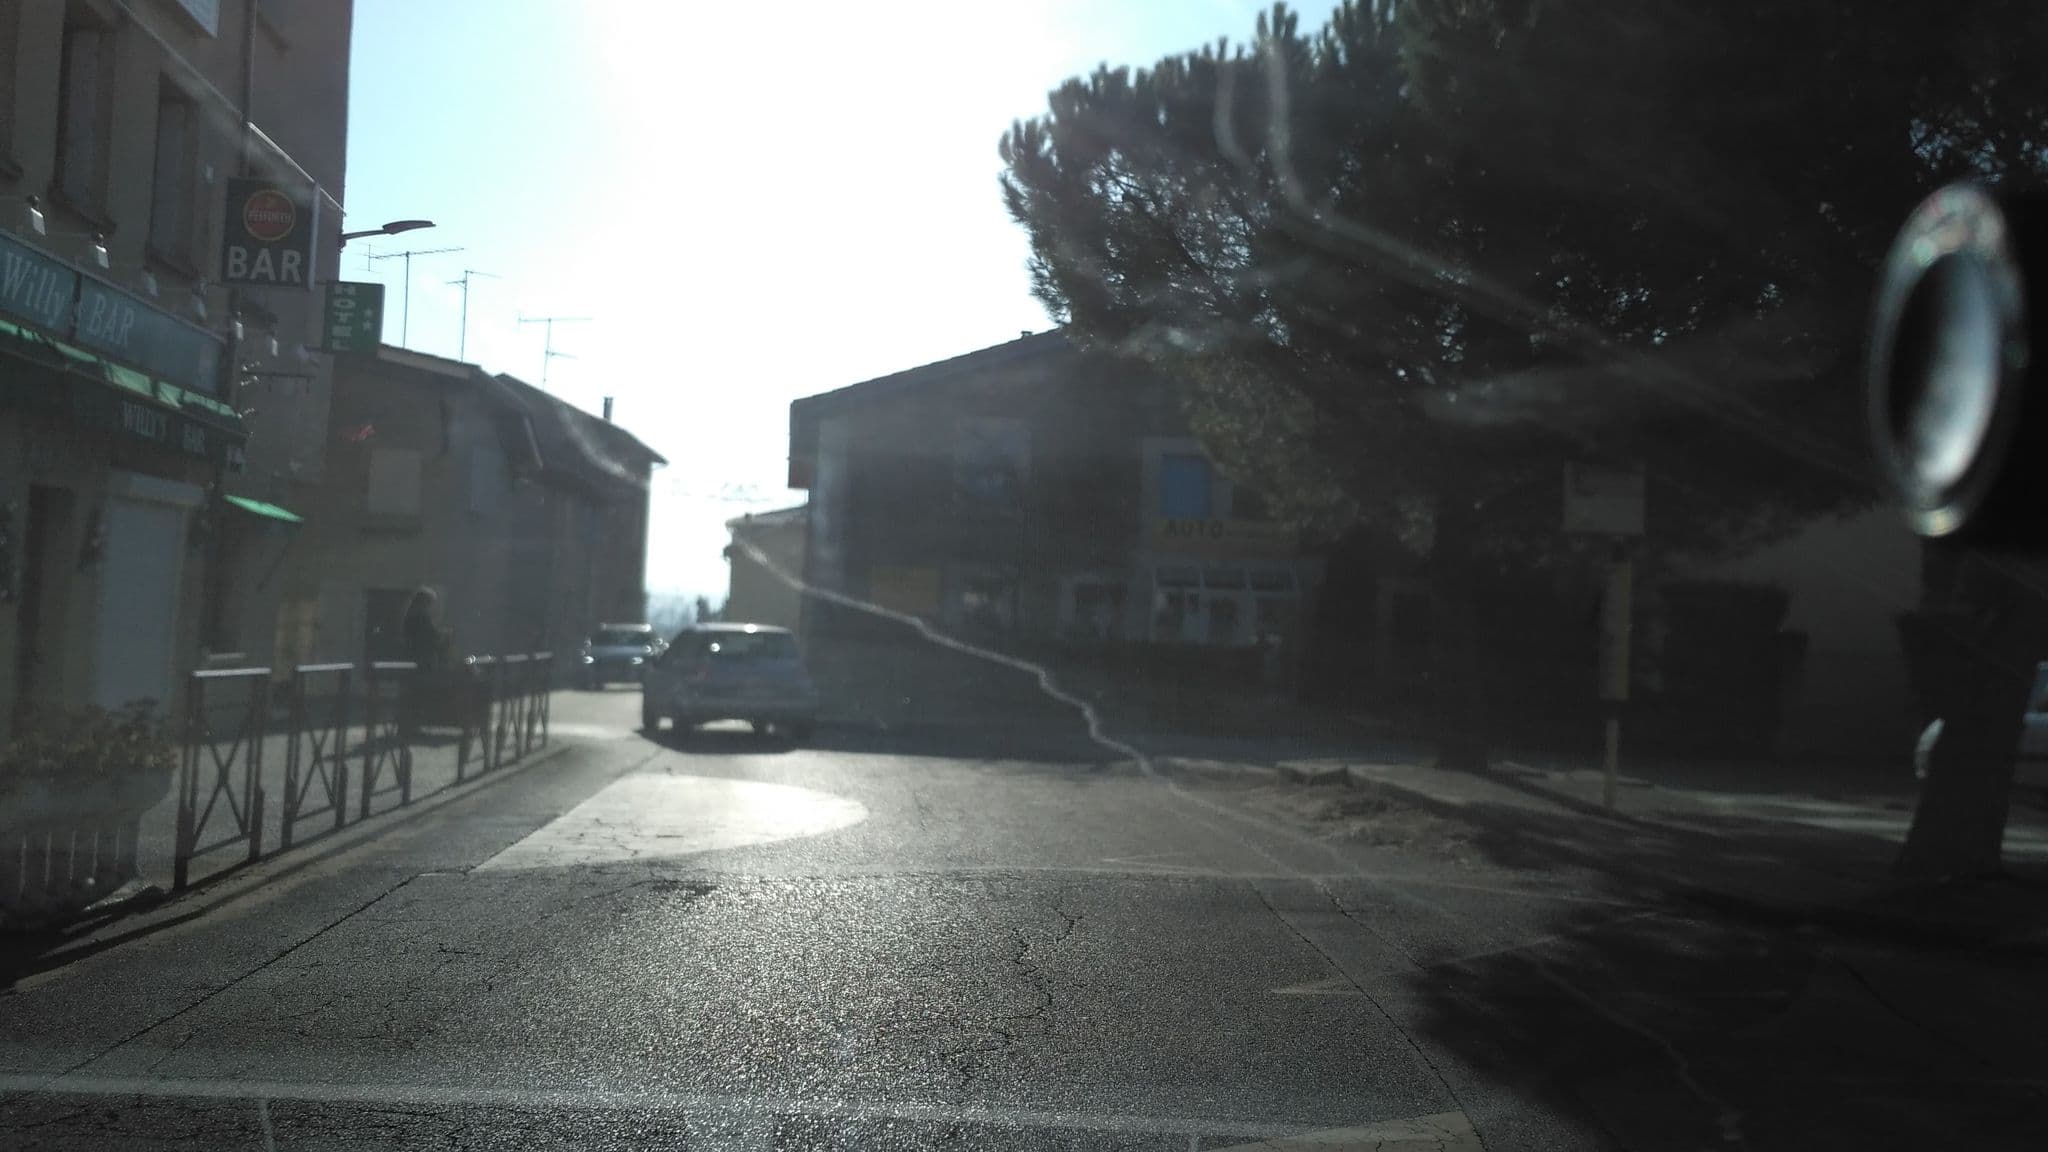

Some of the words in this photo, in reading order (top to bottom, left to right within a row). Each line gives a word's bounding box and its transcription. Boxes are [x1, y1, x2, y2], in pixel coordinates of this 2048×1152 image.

[228, 246, 302, 282] BAR
[86, 292, 135, 349] BAR
[332, 285, 357, 350] HOTEL
[1163, 520, 1224, 539] AUTO
